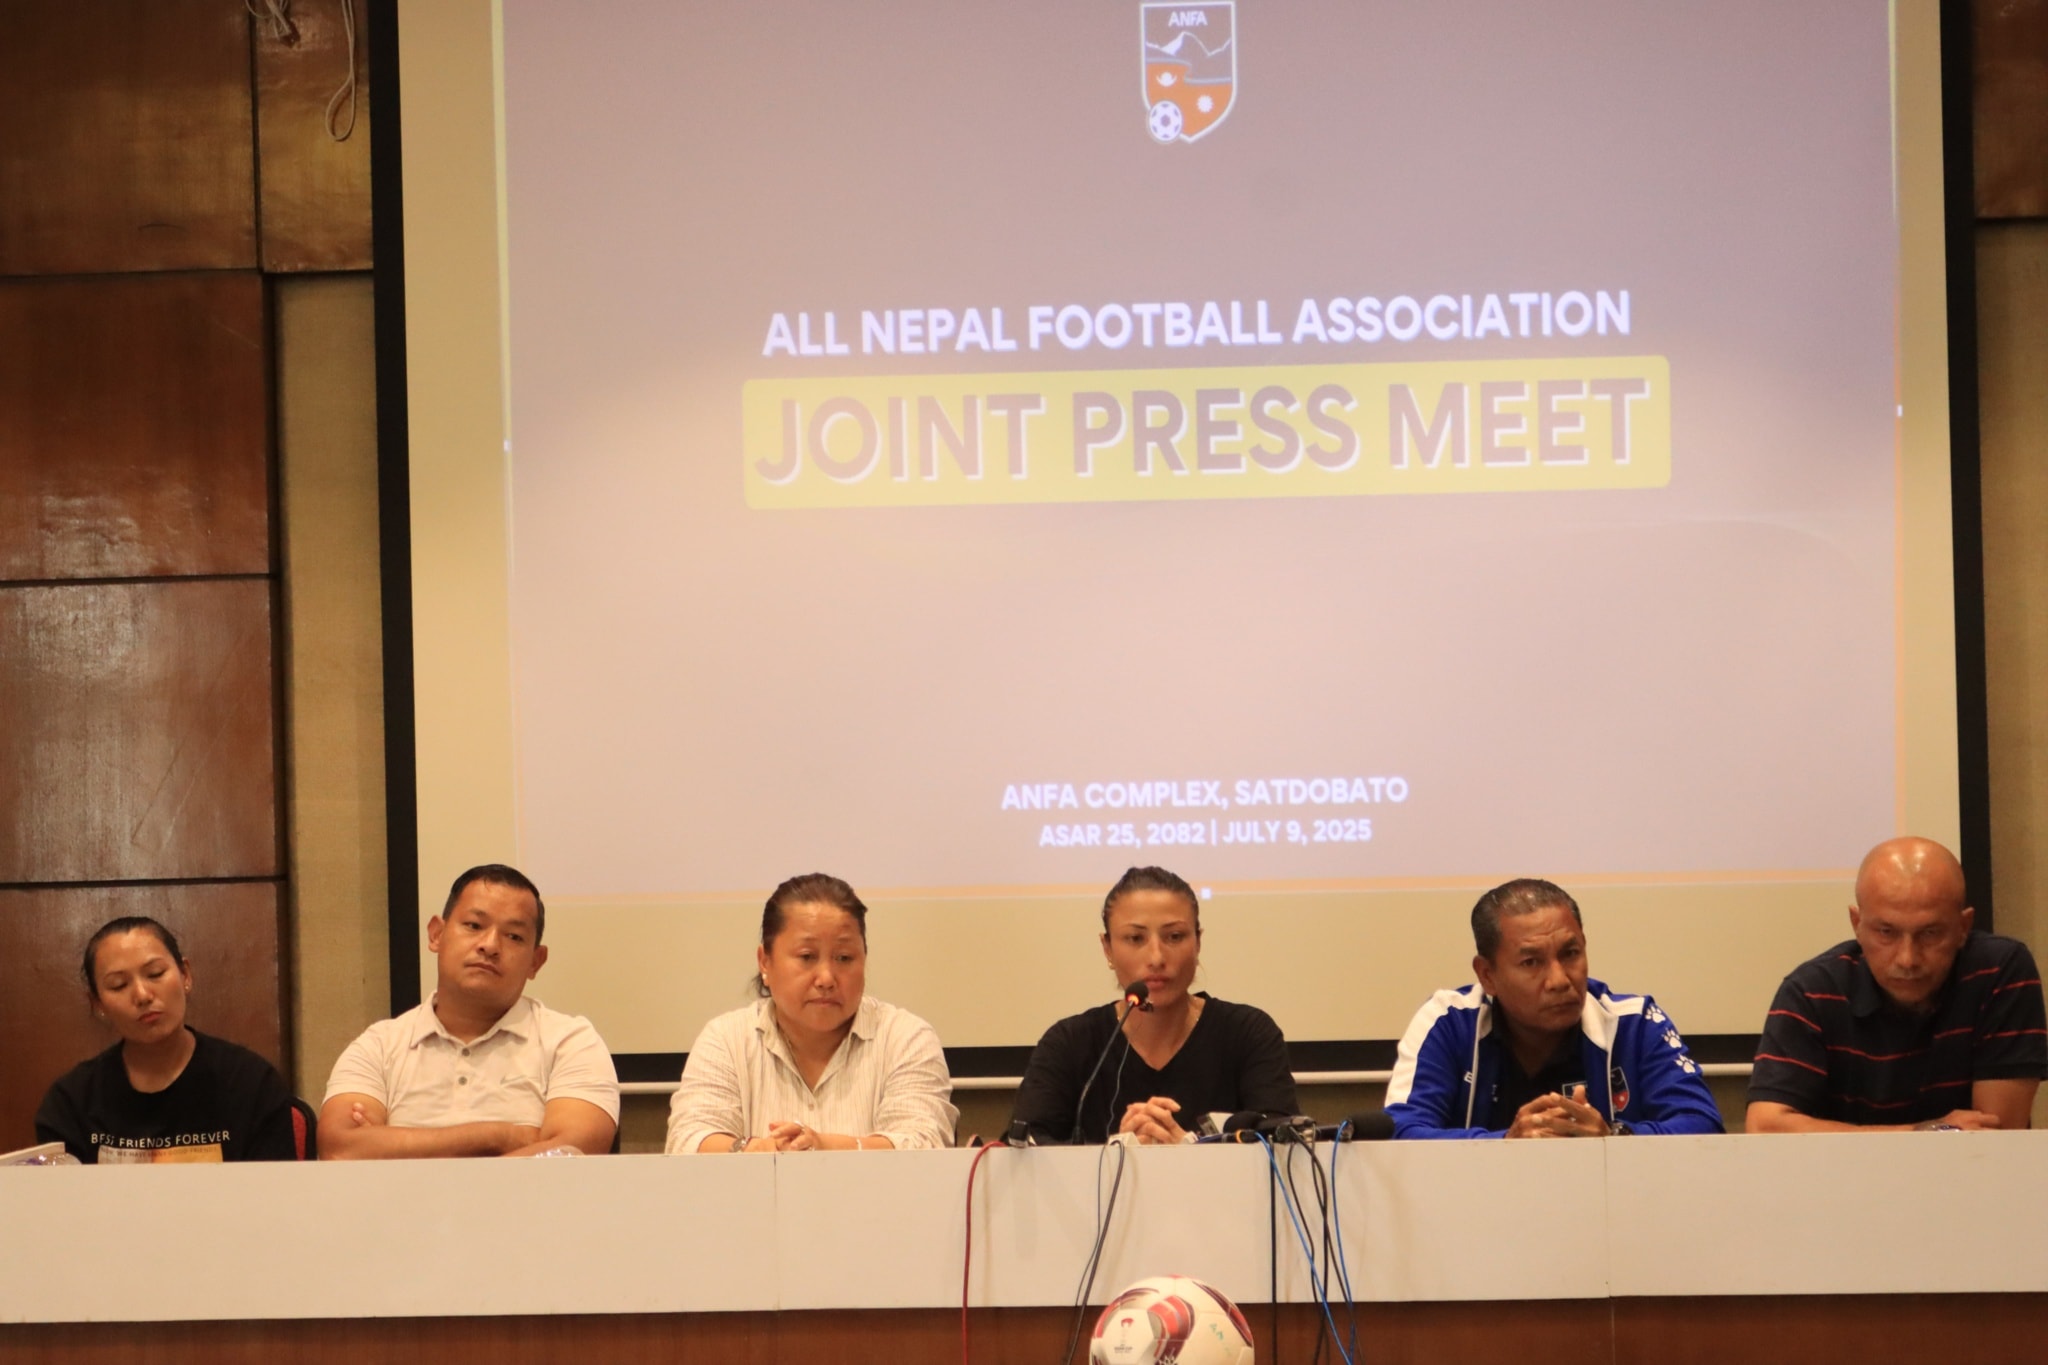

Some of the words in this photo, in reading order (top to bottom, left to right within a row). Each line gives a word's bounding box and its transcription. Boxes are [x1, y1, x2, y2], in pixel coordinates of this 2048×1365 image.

[1168, 10, 1208, 27] ANFA
[762, 312, 850, 356] ALL
[860, 307, 1017, 354] NEPAL
[1028, 299, 1283, 351] FOOTBALL
[1292, 290, 1631, 344] ASSOCIATION
[754, 393, 1046, 485] JOINT
[1071, 383, 1360, 478] PRESS
[1388, 377, 1650, 471] MEET
[1001, 784, 1079, 810] ANFA
[1084, 780, 1229, 811] COMPLEX,
[1234, 776, 1409, 805] SATDOBATO
[1039, 824, 1101, 847] ASAR
[1106, 823, 1142, 849] 25,
[1147, 821, 1206, 846] 2082
[1222, 820, 1281, 844] JULY
[1286, 820, 1308, 846] 9,
[1312, 818, 1372, 842] 2025
[119, 1137, 171, 1148] FRIENDS
[175, 1130, 230, 1145] FOREVER
